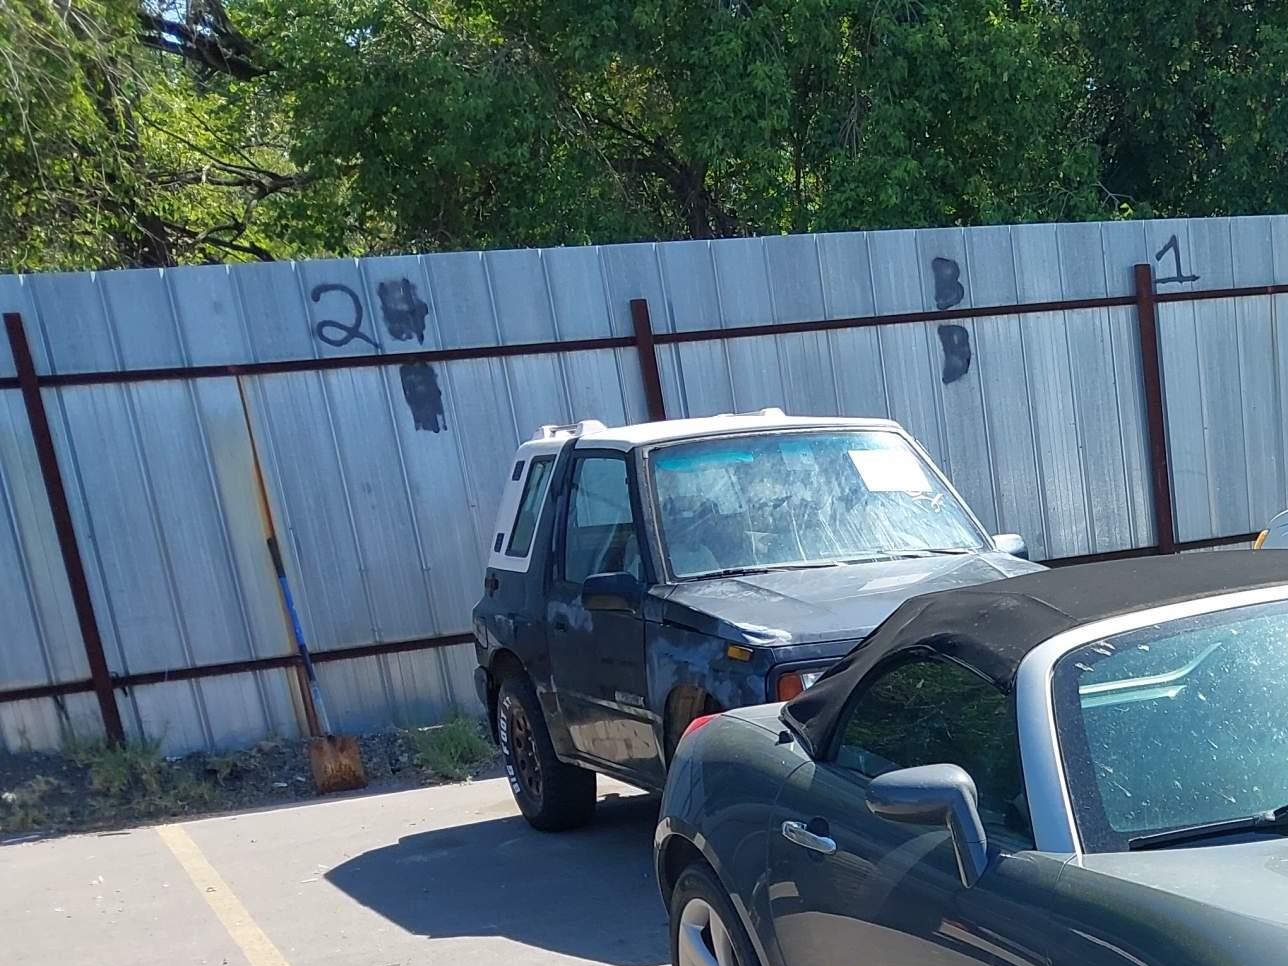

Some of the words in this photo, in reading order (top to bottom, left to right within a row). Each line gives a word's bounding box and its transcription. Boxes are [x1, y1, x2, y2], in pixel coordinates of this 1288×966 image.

[1155, 234, 1200, 284] 1
[311, 283, 382, 349] 2
[500, 709, 510, 756] FOOT
[506, 765, 521, 794] BIG
